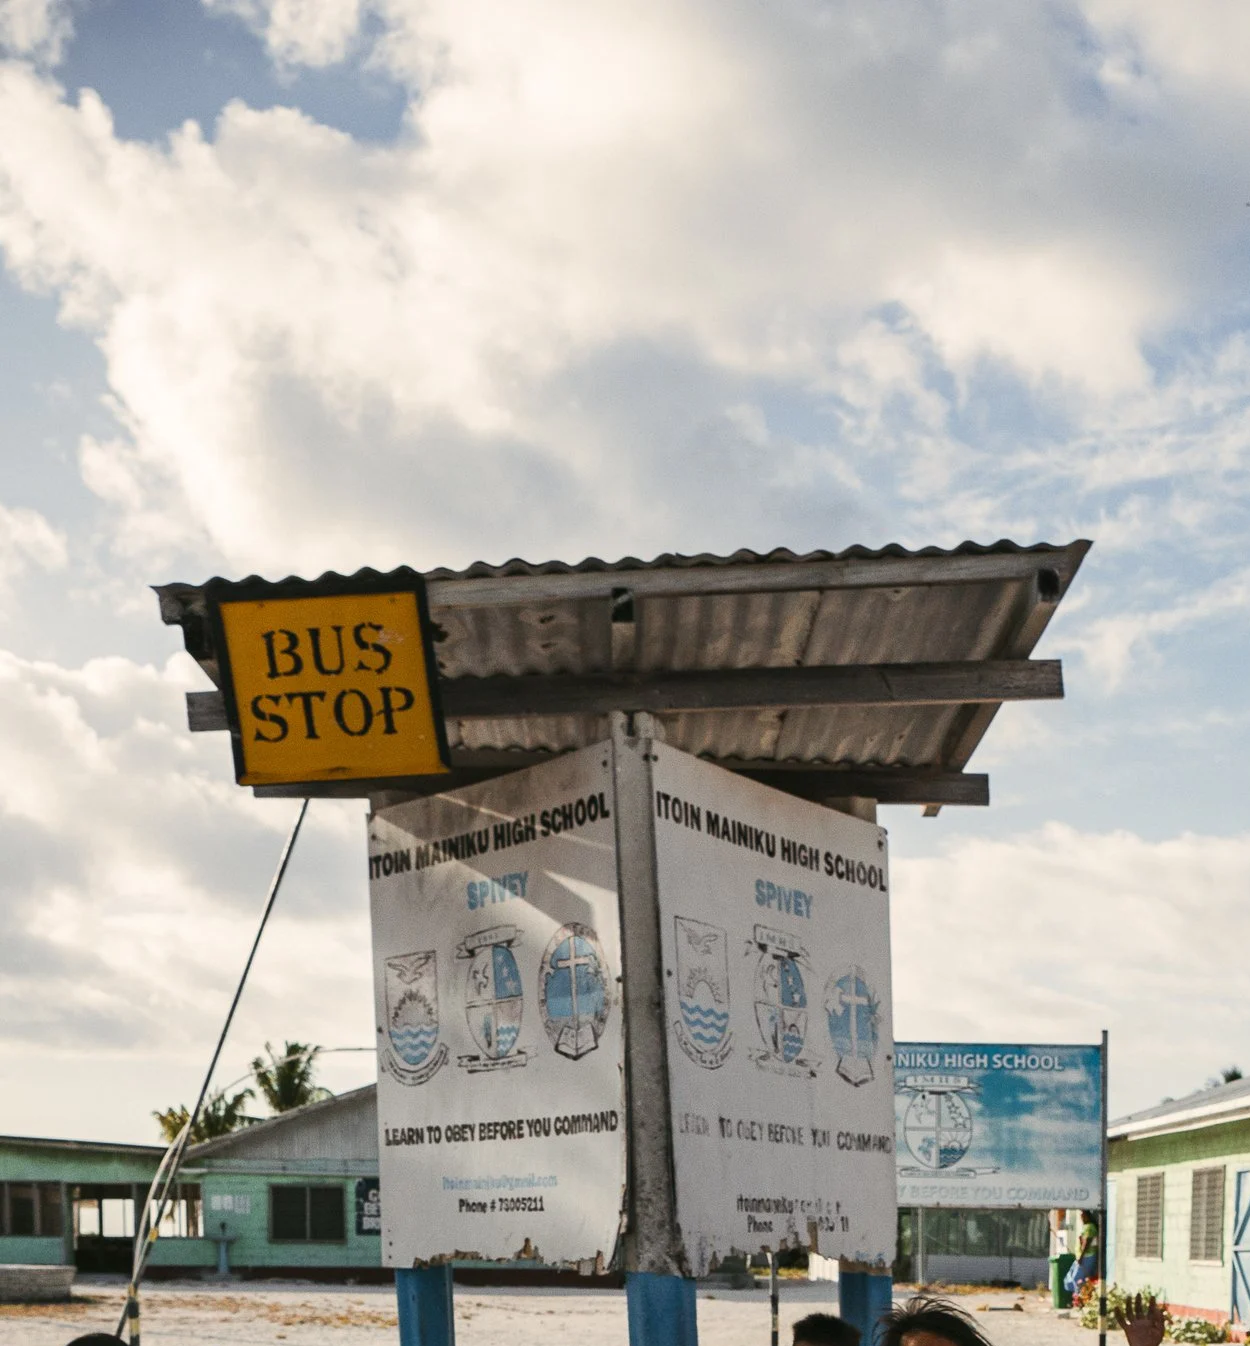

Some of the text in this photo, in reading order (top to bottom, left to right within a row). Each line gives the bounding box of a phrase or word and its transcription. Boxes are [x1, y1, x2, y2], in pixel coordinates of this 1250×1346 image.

[261, 621, 394, 679] BUS
[250, 686, 416, 743] STOP
[415, 828, 490, 870] MAINIKU
[493, 814, 537, 850] HIGH
[539, 792, 611, 838] SCHOOL
[656, 791, 888, 892] ITOIN MAINIKU HIGH SCHOOL
[466, 870, 530, 911] SPIVEY
[755, 879, 814, 919] SPIVEY
[944, 1053, 988, 1068] HIGH
[992, 1053, 1065, 1071] SCHOOL
[384, 1109, 619, 1146] LEARN TO OBEY BEFORE YOU COMMAND
[719, 1116, 732, 1138] TO
[459, 1199, 487, 1213] Phone
[1006, 1187, 1090, 1201] COMMAND
